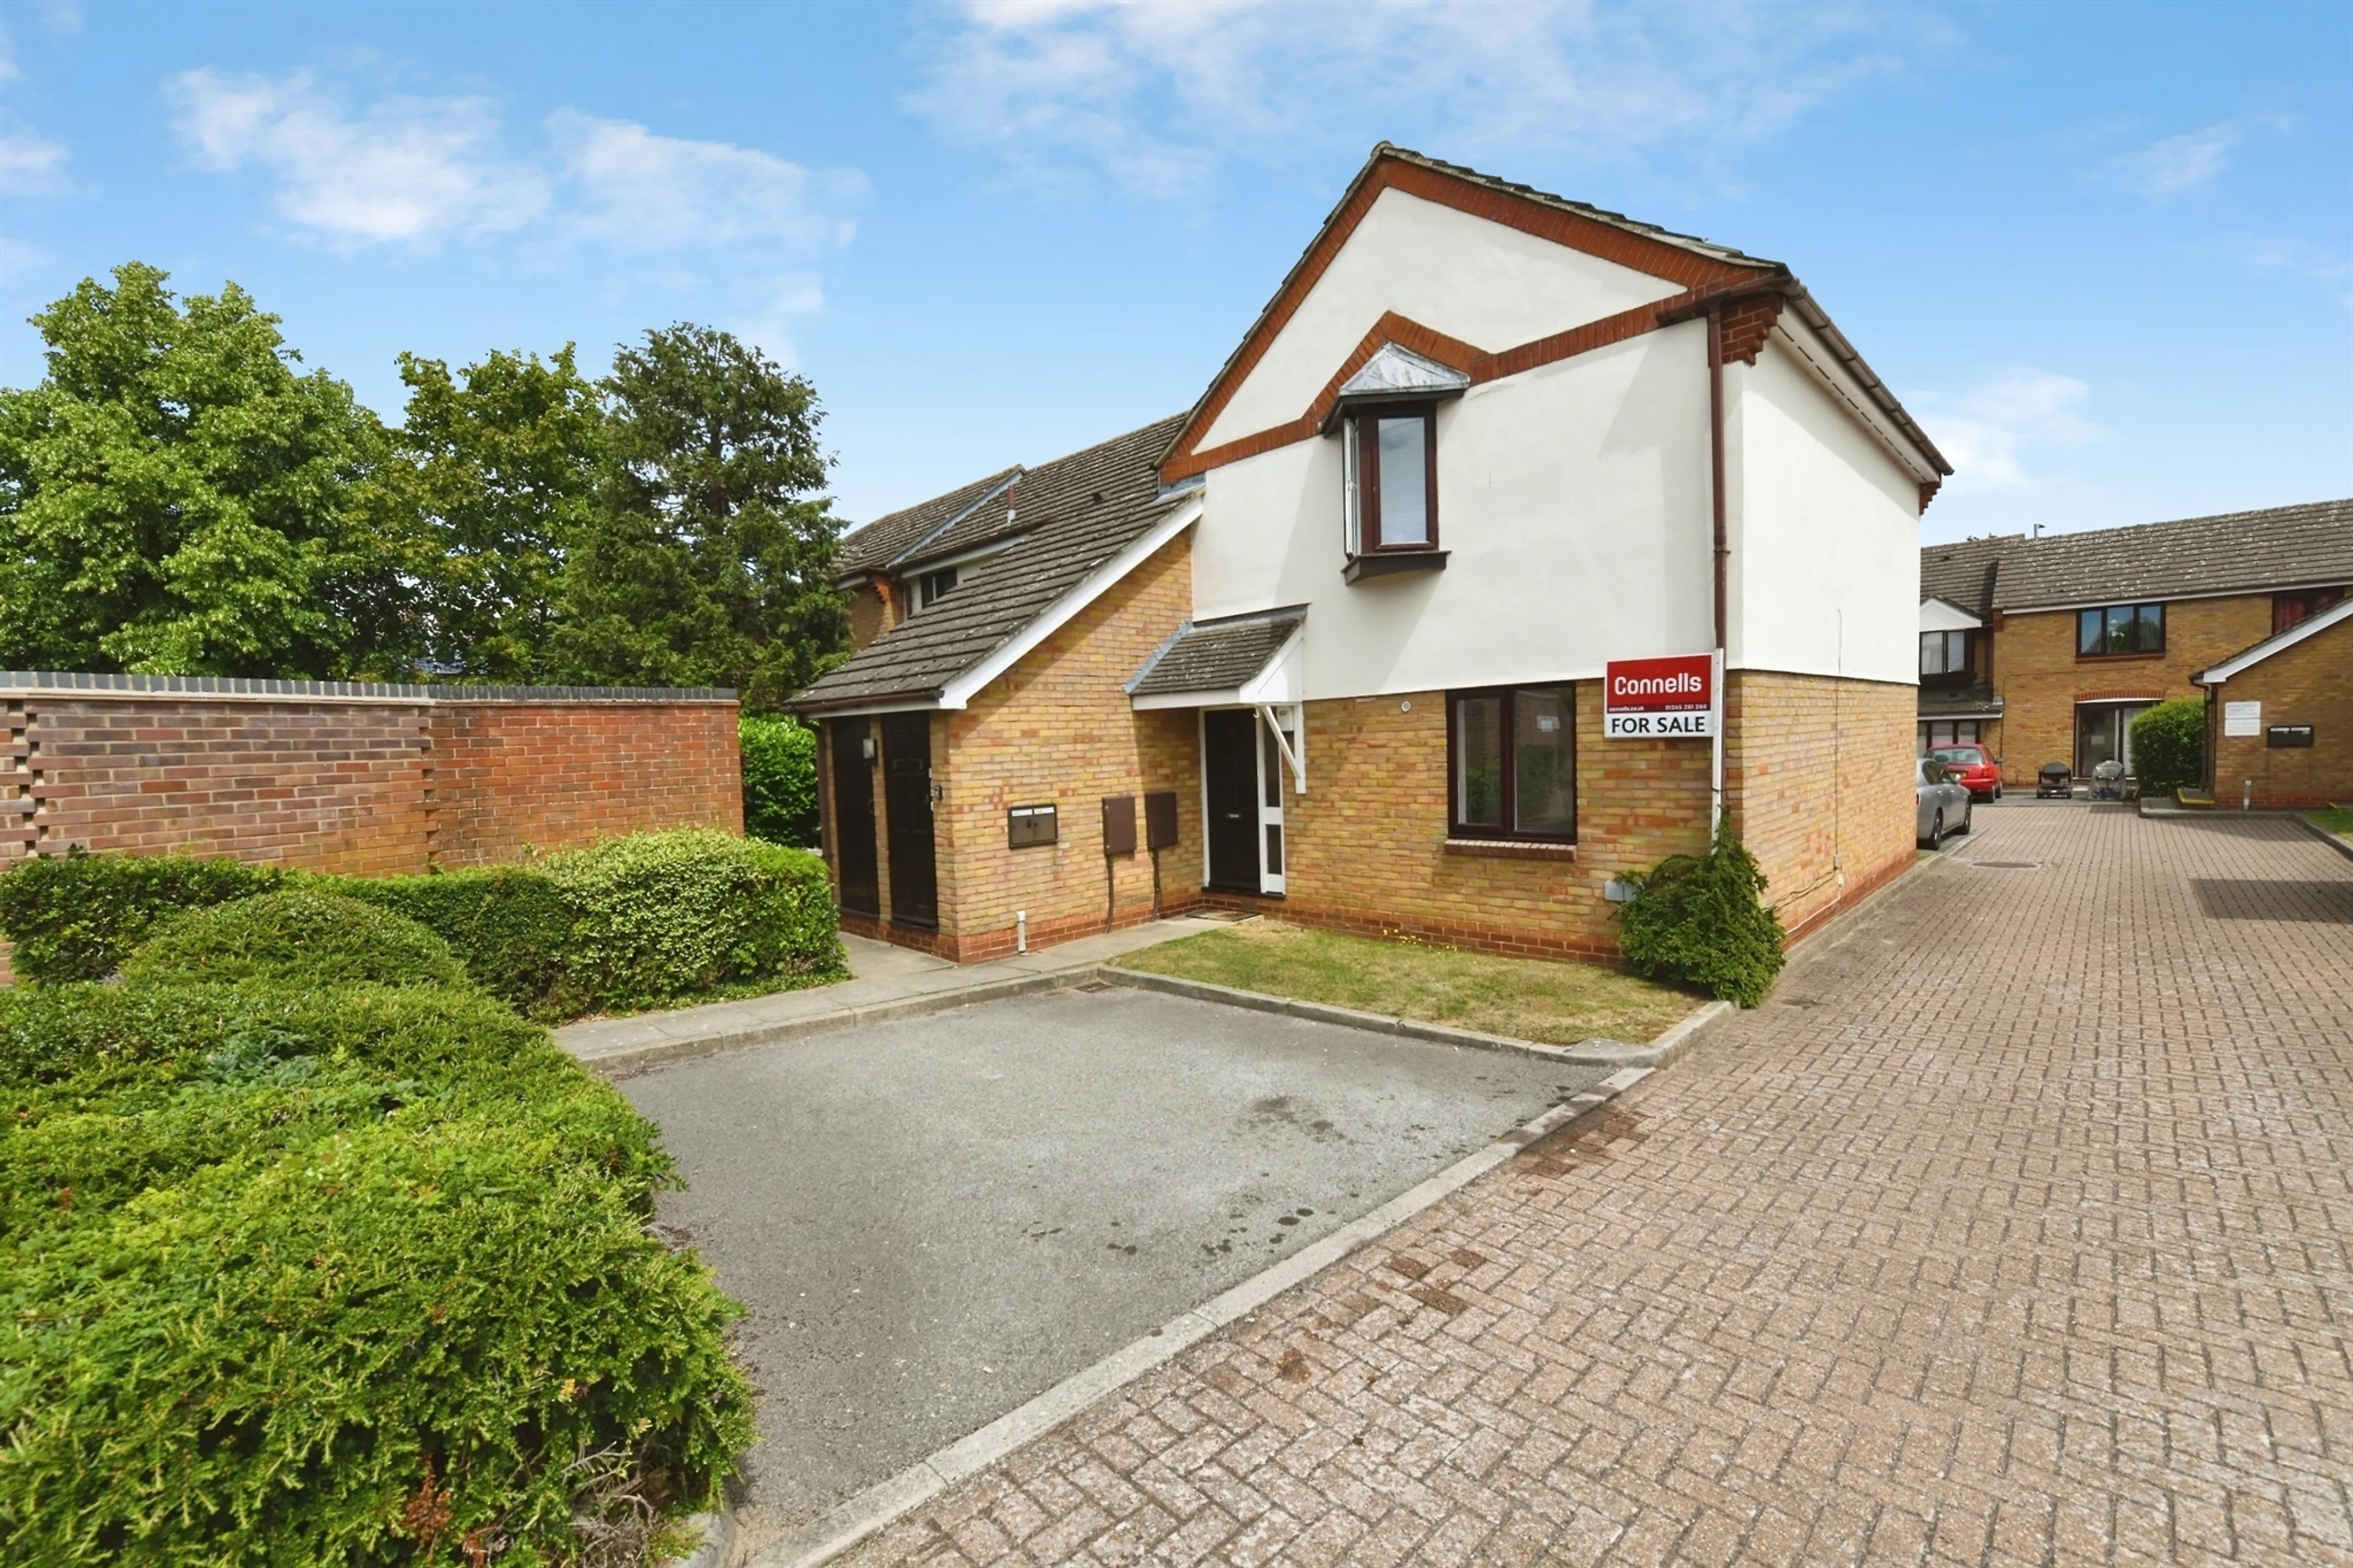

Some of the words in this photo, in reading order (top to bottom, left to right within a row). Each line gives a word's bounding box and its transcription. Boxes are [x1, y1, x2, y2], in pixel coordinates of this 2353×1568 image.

[1615, 673, 1702, 695] Connells
[1612, 718, 1650, 733] FOR
[1657, 716, 1705, 733] SALE
